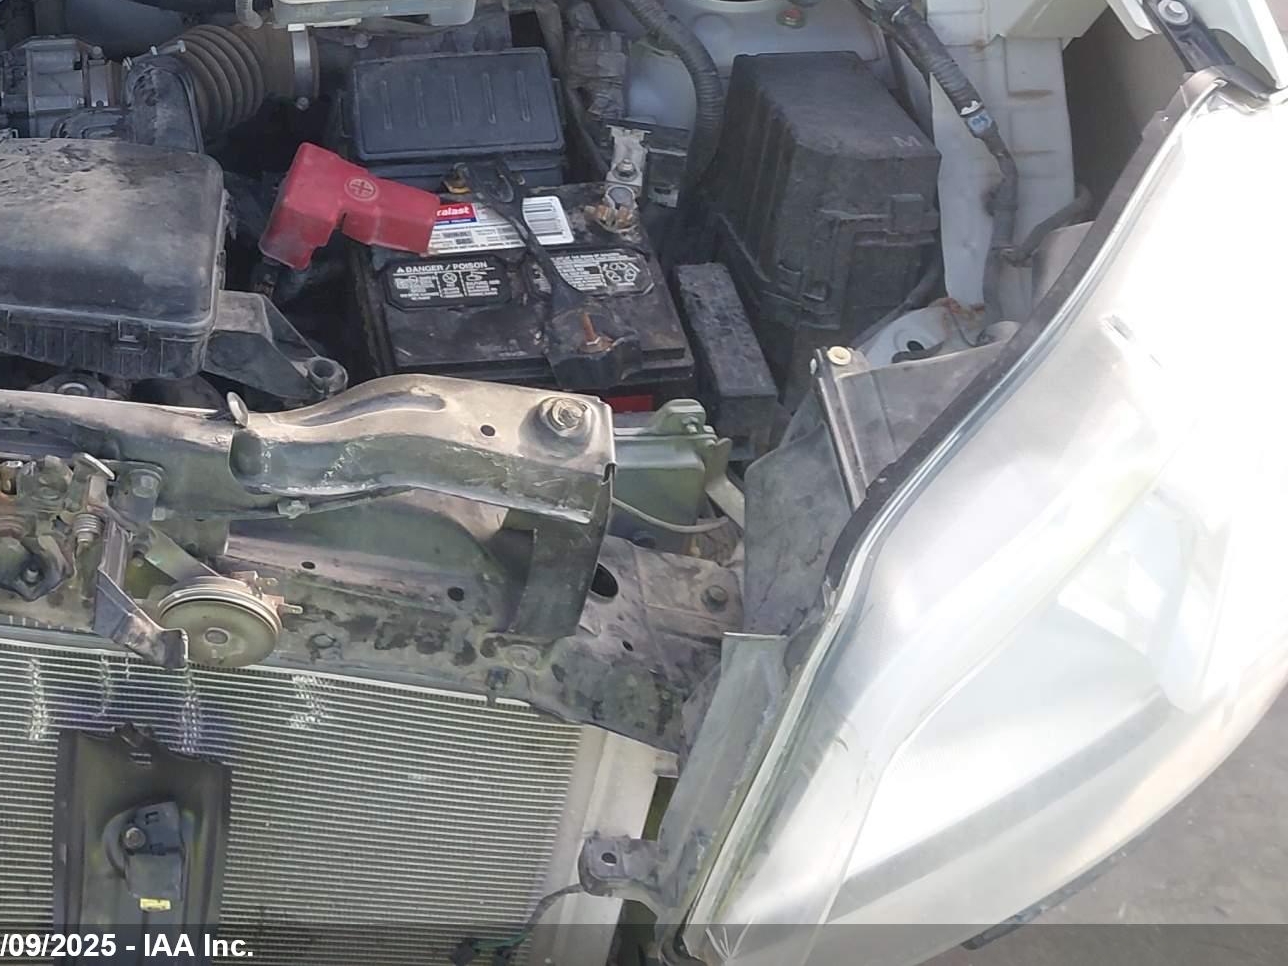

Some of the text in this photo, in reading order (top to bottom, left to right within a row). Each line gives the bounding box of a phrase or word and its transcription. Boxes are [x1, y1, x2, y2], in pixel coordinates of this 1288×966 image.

[436, 206, 470, 217] ralast
[405, 264, 444, 274] DANGER
[452, 261, 488, 270] POISON
